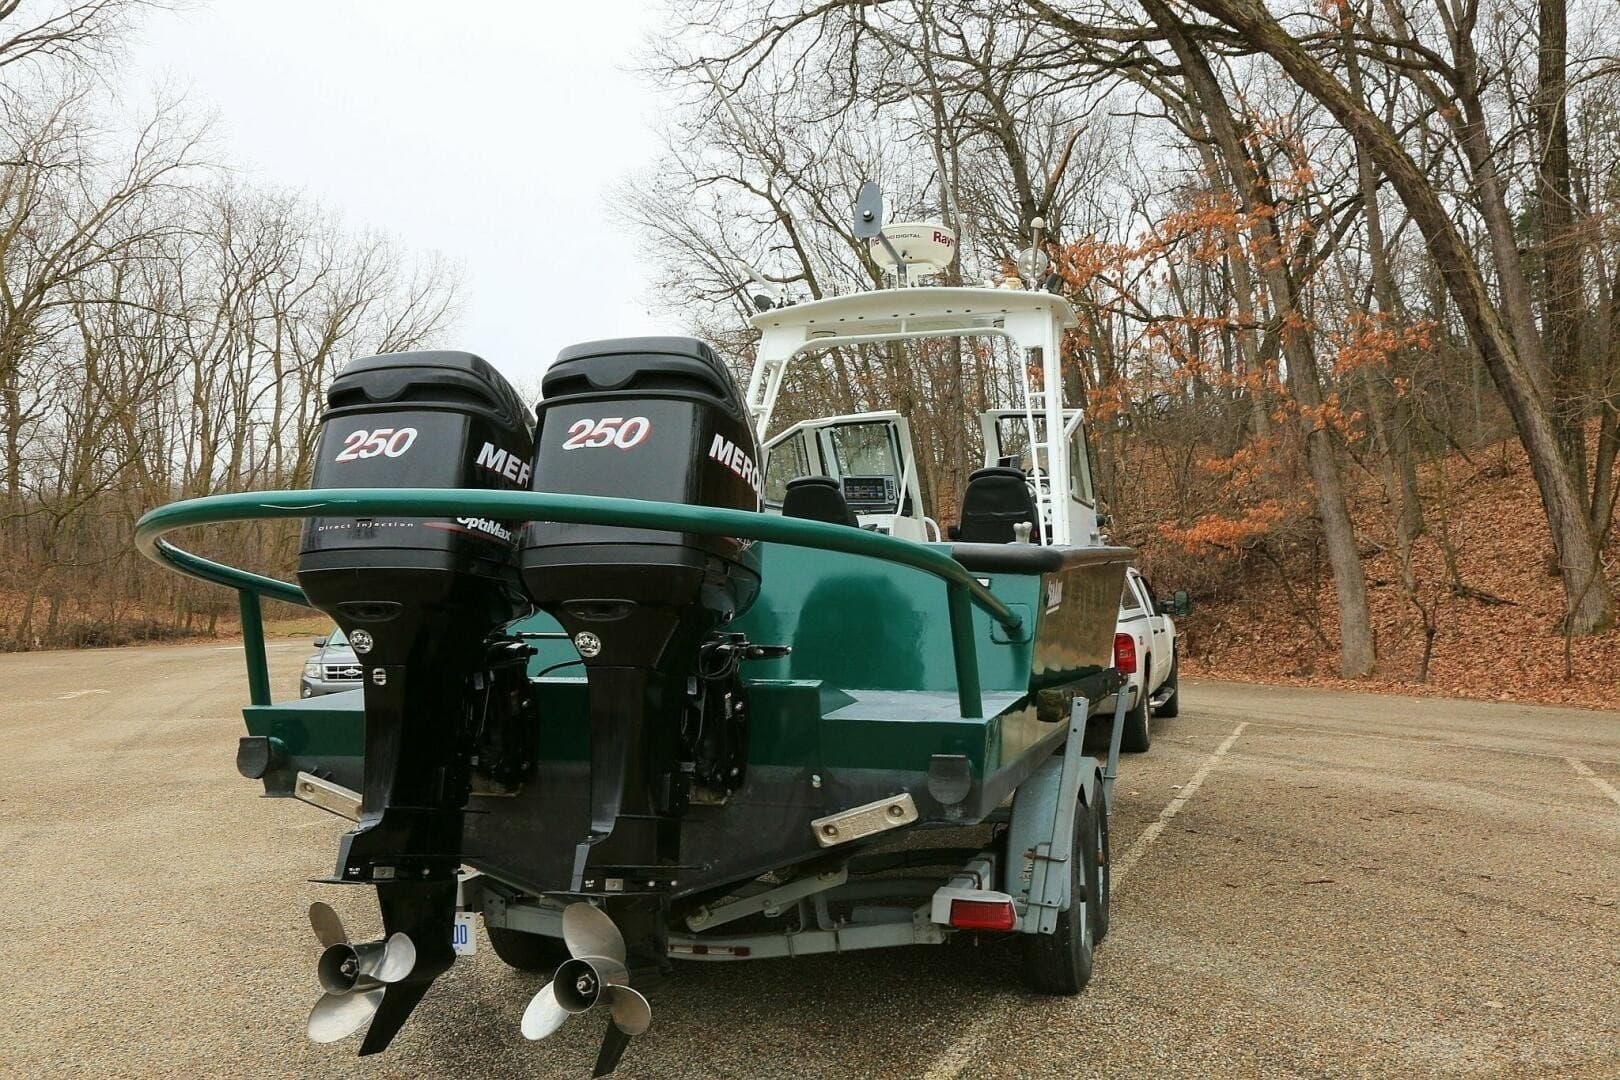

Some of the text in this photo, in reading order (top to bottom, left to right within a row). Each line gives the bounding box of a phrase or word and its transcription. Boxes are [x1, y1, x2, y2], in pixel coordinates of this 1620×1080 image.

[335, 428, 418, 463] 250
[562, 416, 651, 451] 250
[318, 523, 351, 532] Direct
